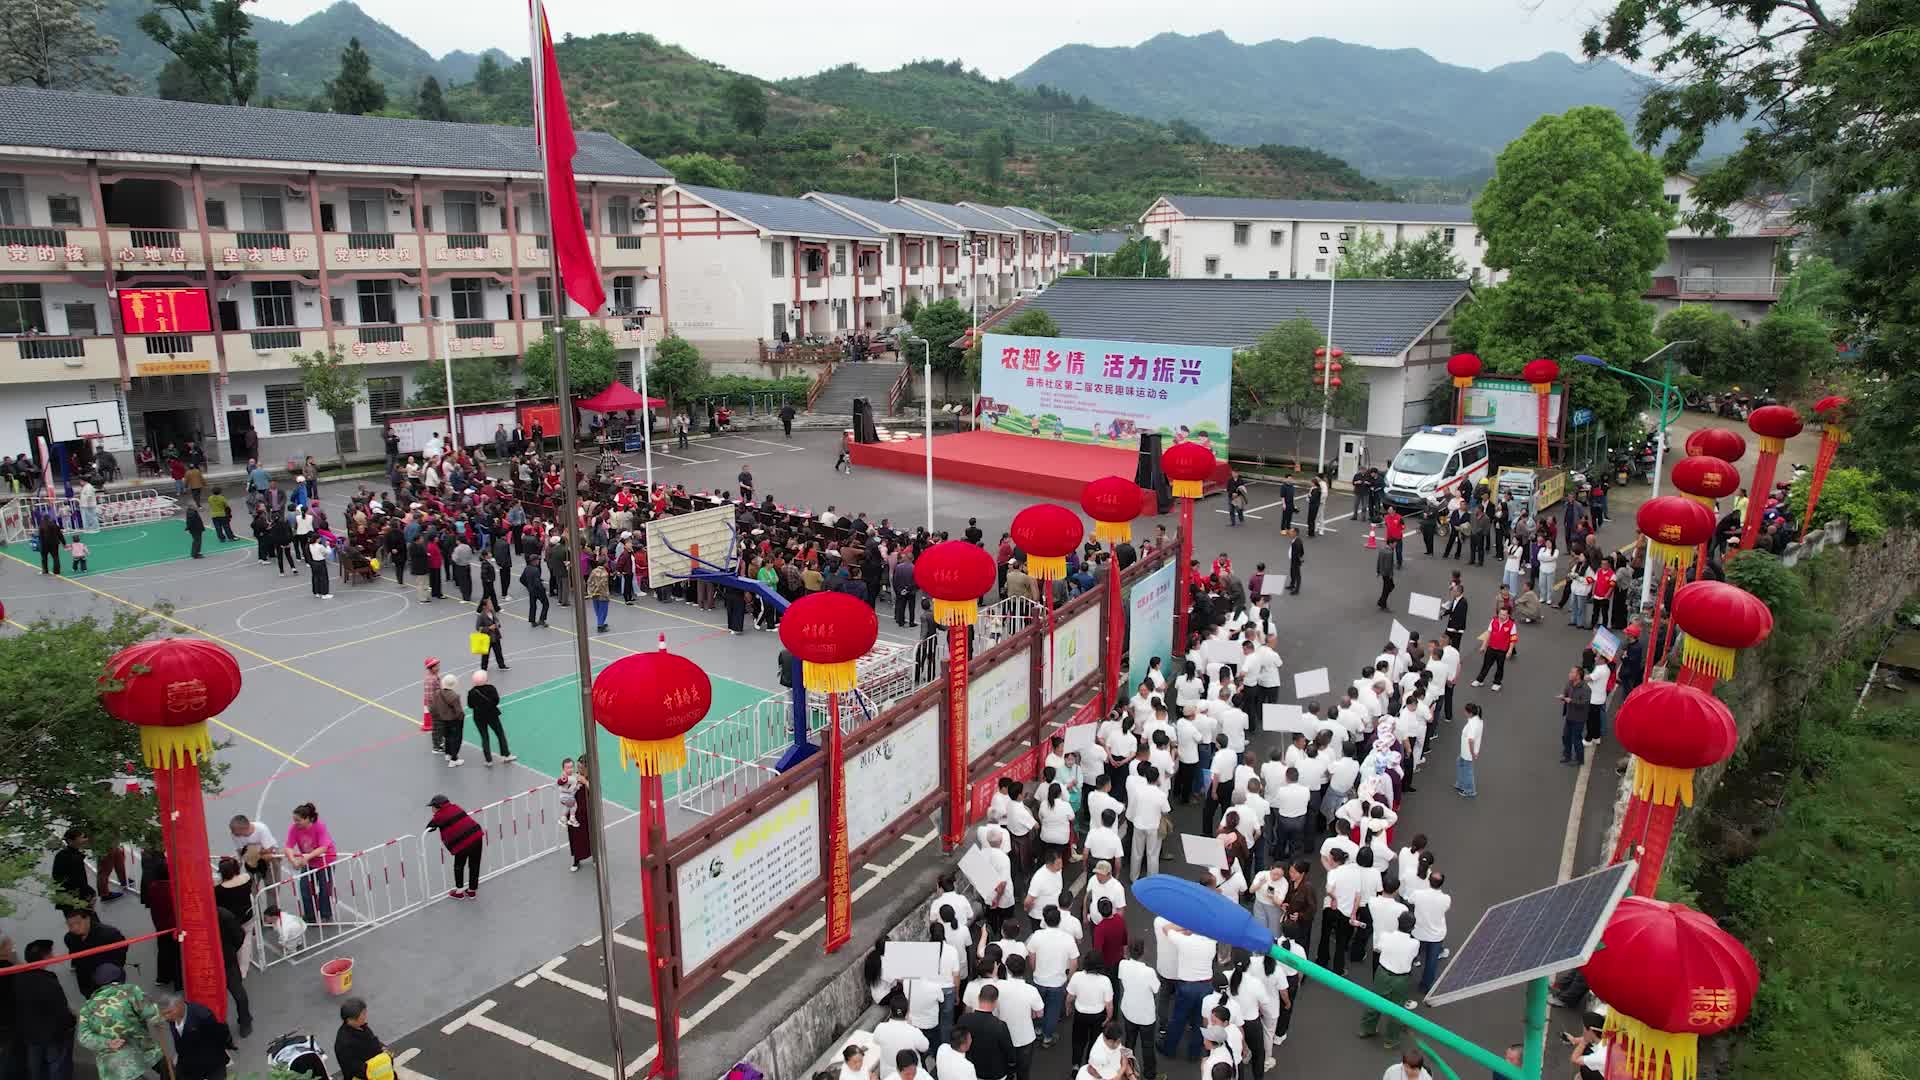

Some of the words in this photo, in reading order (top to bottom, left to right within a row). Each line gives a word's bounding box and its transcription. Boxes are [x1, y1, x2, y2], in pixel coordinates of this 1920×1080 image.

[8, 243, 84, 263] 党的核
[119, 245, 188, 263] 心地位
[223, 246, 309, 263] 坚决维护
[335, 246, 412, 263] 党中央权
[1001, 347, 1086, 376] 农趣乡情
[1103, 354, 1202, 385] 活力振兴
